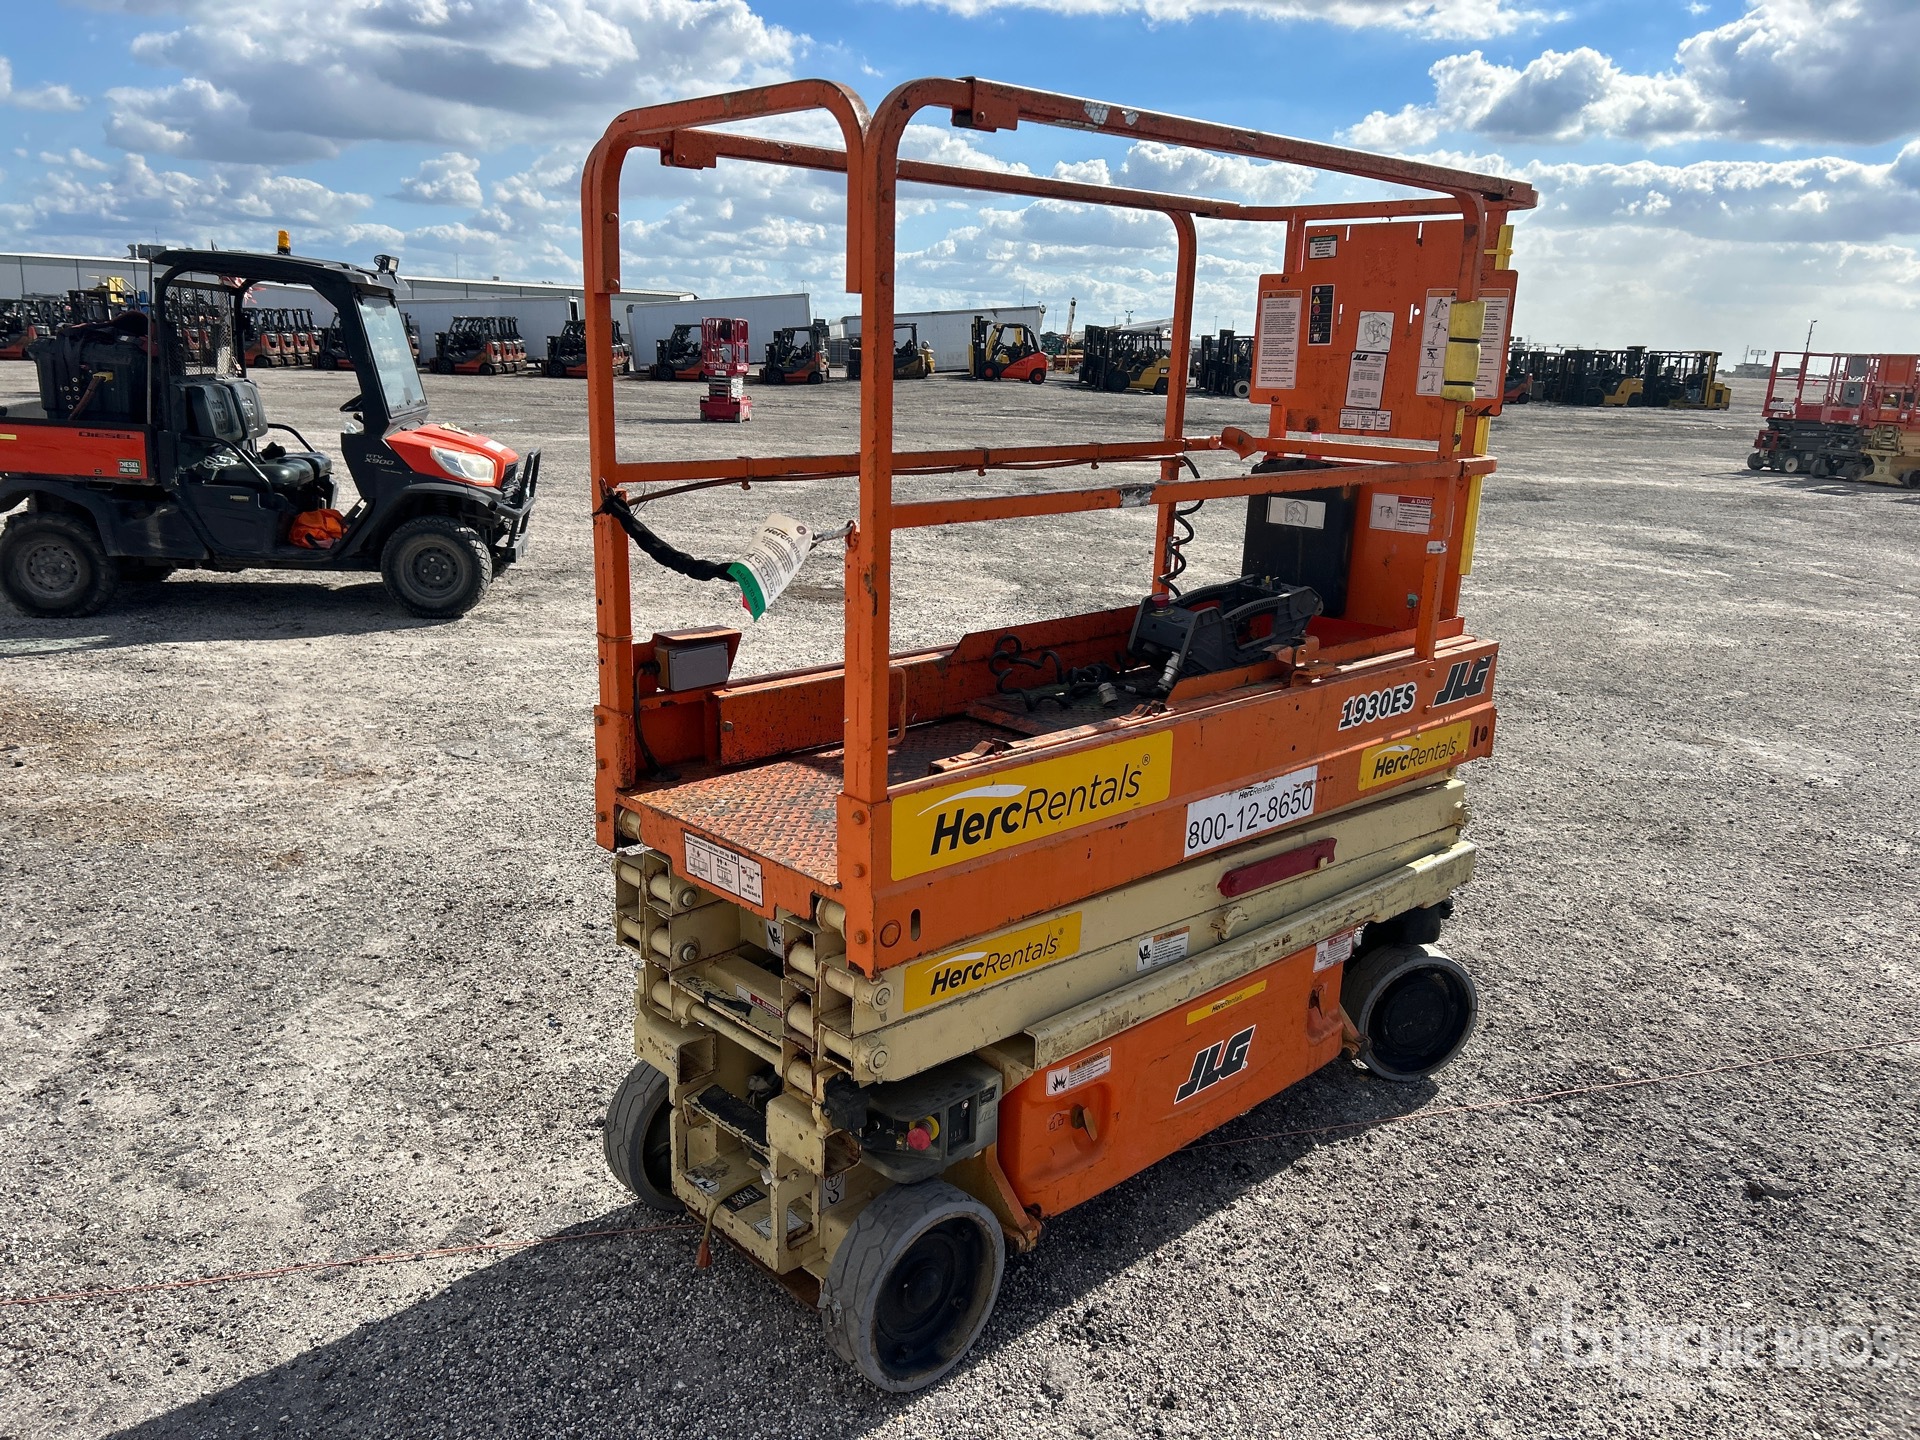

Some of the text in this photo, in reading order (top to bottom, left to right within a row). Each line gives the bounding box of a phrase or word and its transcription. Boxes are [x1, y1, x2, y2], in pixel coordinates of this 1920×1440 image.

[79, 431, 136, 439] DIESEL
[364, 457, 394, 465] X900
[1434, 654, 1493, 706] JLG
[1339, 683, 1416, 730] 1930ES
[1187, 785, 1313, 850] 800-12-8650
[1174, 1024, 1256, 1105] JLG
